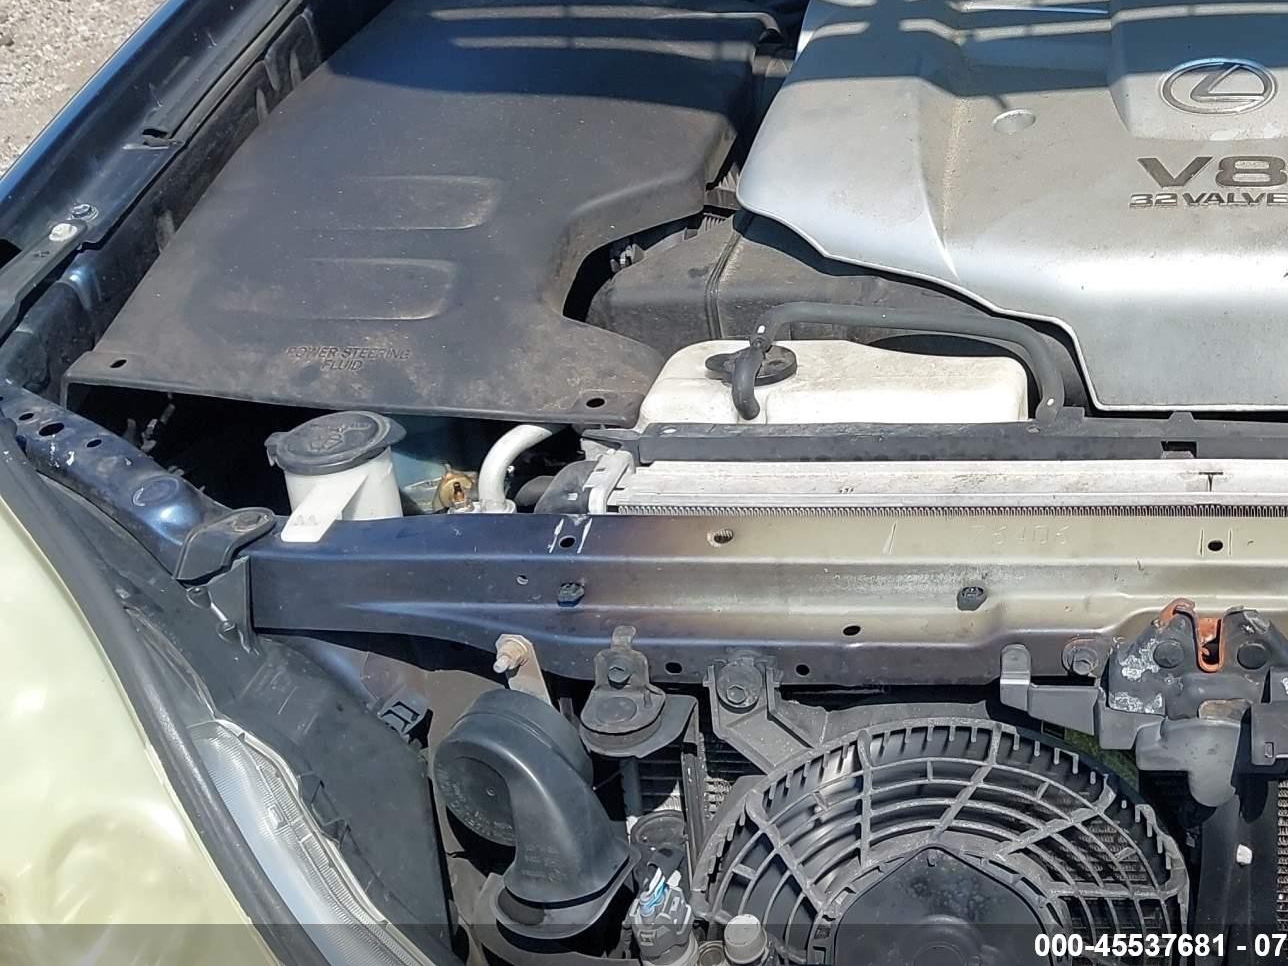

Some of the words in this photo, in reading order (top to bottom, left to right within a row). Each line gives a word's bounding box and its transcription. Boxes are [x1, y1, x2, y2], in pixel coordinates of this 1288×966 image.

[1137, 155, 1288, 188] V8
[1129, 192, 1178, 208] 32
[285, 346, 338, 359] POWER
[340, 346, 411, 360] STEERING
[320, 359, 362, 371] FLUID
